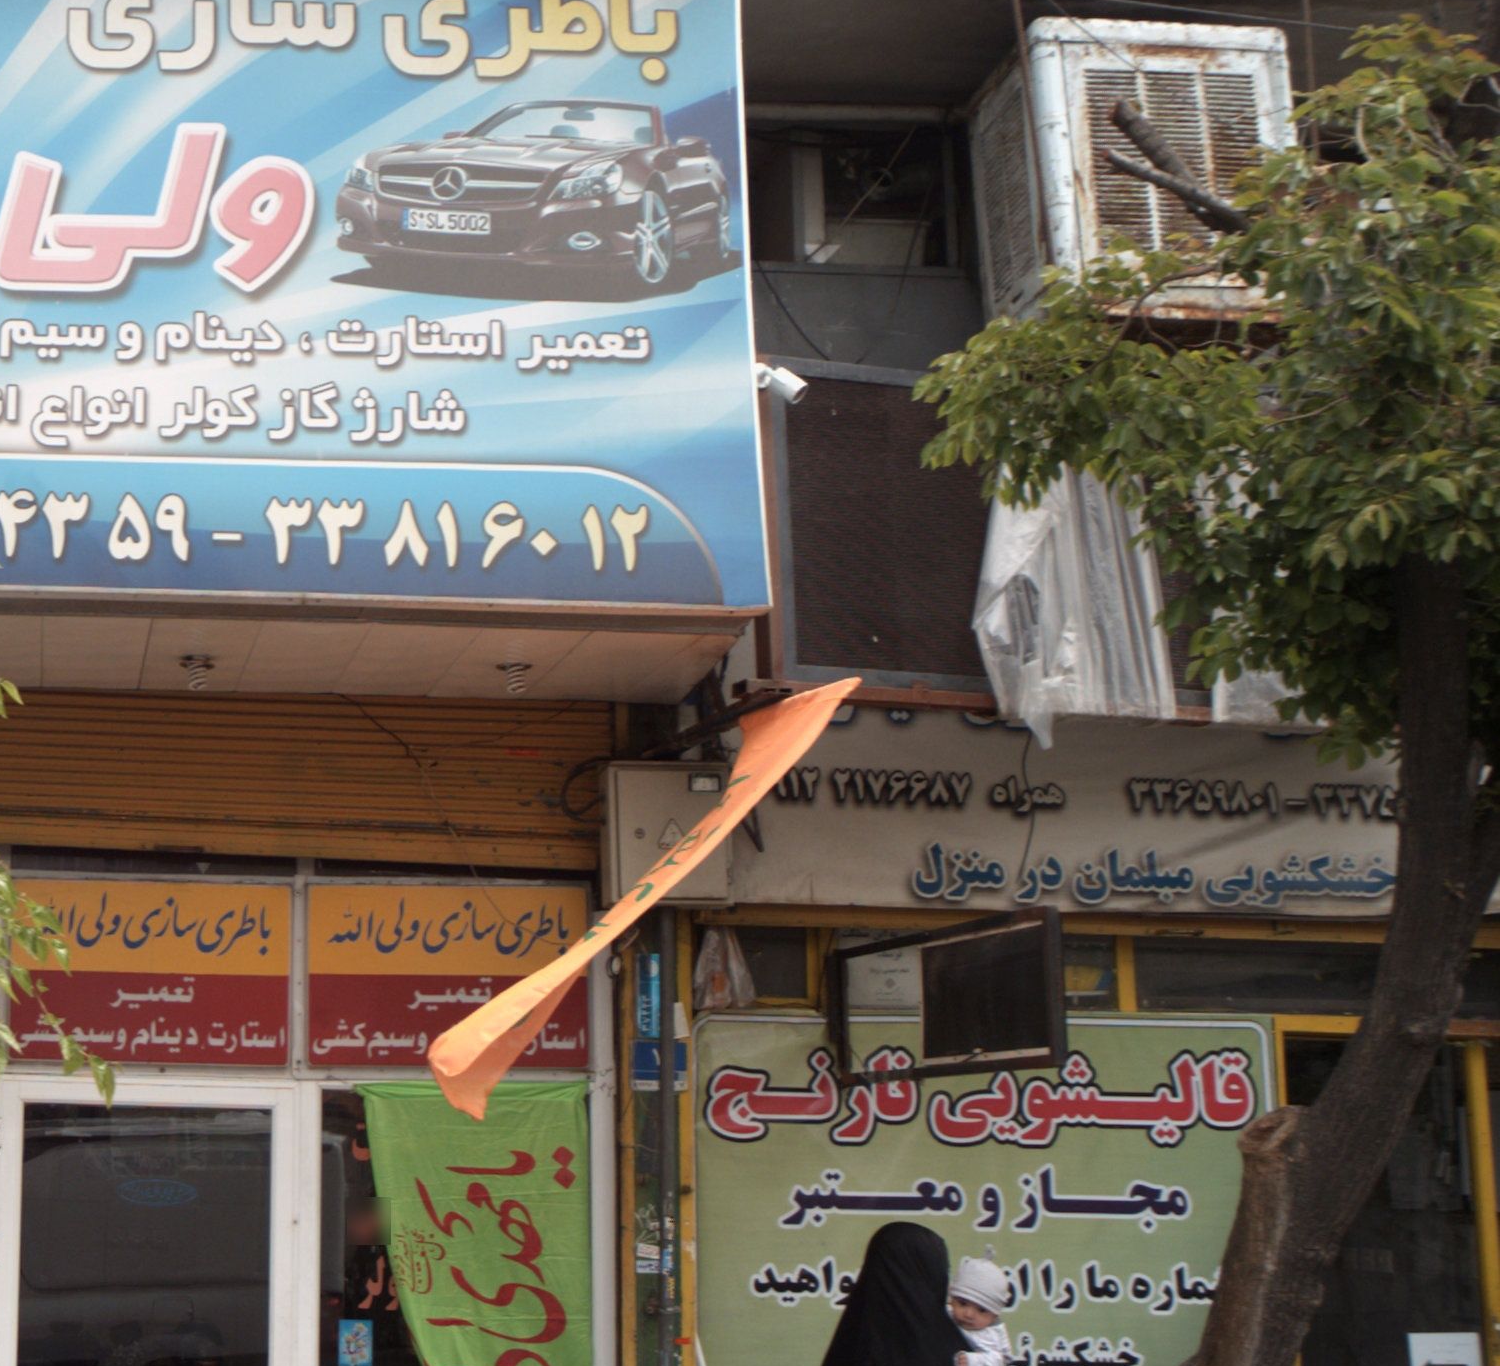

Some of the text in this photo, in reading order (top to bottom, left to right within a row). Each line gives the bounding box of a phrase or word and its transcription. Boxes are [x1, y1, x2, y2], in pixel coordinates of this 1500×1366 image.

[0, 318, 106, 359] سیم
[115, 320, 143, 362] و
[153, 311, 283, 364] دینام
[326, 315, 503, 365] استارت
[518, 324, 651, 370] تعمیر
[30, 385, 147, 447] انواع
[159, 384, 258, 438] کولر
[267, 382, 340, 441] گاز
[349, 388, 467, 442] شارژ
[990, 775, 1066, 813] همراه
[912, 841, 1006, 902] منزل
[1014, 853, 1063, 903] در
[1073, 847, 1194, 904] مبلمان
[76, 890, 121, 948] ولی
[123, 896, 197, 950] سازی
[196, 904, 272, 956] باطری
[375, 897, 421, 954] ولی
[422, 900, 497, 954] سازی
[495, 904, 569, 958] باطری
[109, 977, 195, 1009] تعمیر
[408, 977, 492, 1011] تعمیر
[131, 1017, 199, 1055] دینام
[207, 1021, 286, 1054] استارت
[929, 1049, 1257, 1147] قالیشویی
[781, 1164, 1190, 1231] مجاز و معتبر
[1085, 1261, 1120, 1301] ما
